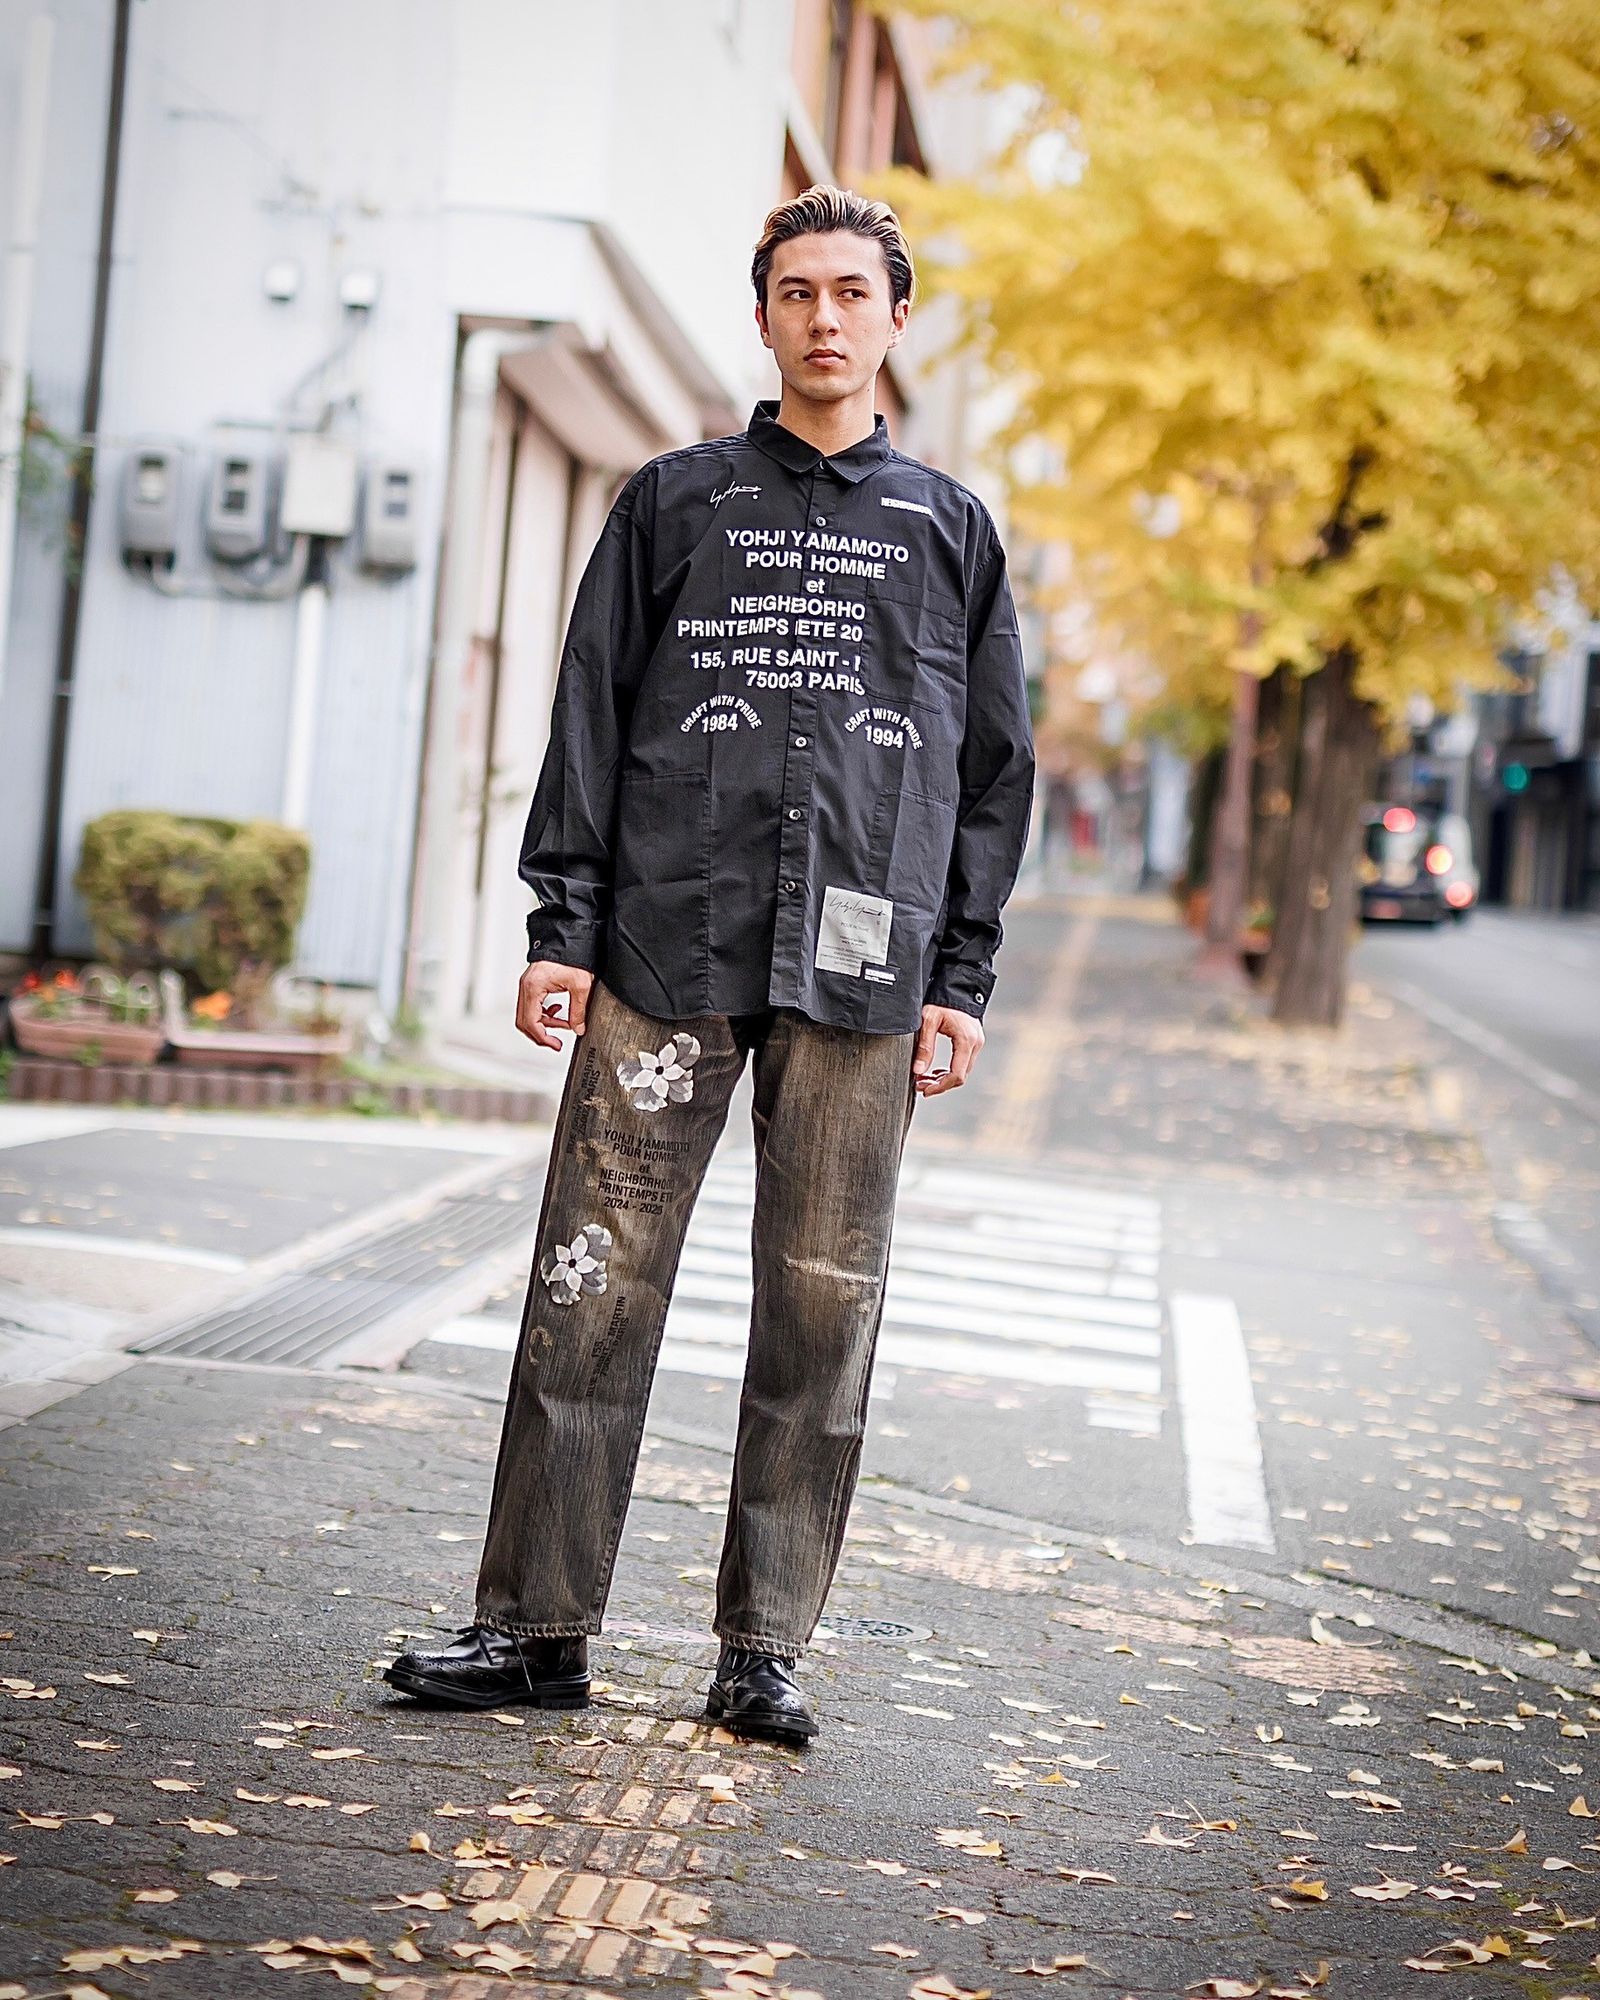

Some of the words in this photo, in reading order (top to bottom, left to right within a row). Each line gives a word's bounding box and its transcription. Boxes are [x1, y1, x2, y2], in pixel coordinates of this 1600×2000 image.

[725, 530, 786, 547] YOHJI
[790, 530, 909, 563] YAMAMOTO
[745, 551, 803, 570] POUR
[810, 554, 886, 580] HOMME
[805, 578, 826, 594] et
[730, 594, 866, 621] NEIGHBORHO
[677, 616, 789, 637] PRINTEMPS
[794, 618, 837, 638] ETE
[840, 624, 863, 642] 20
[690, 650, 726, 670] 155,
[731, 647, 772, 666] RUE
[775, 648, 840, 668] SAINT
[745, 669, 803, 690] 75003
[807, 671, 866, 696] PARIS
[680, 701, 708, 733] CRAFT
[709, 694, 736, 709] WITH
[734, 697, 763, 730] PRIDE
[701, 713, 739, 733] 1984
[844, 708, 871, 733] CRAFT
[872, 707, 902, 724] WITH
[900, 716, 923, 750] PRIDE
[864, 724, 904, 749] 1994
[585, 1070, 601, 1101] PARIS
[604, 1128, 635, 1147] YOHJI
[637, 1137, 690, 1153] YAMAMOTO
[612, 1142, 642, 1160] POUR
[643, 1149, 680, 1164] HOMME
[639, 1163, 651, 1174] et
[597, 1180, 659, 1202] PRINTEMPS
[603, 1196, 630, 1210] 2024
[608, 1295, 626, 1336] MARTIN
